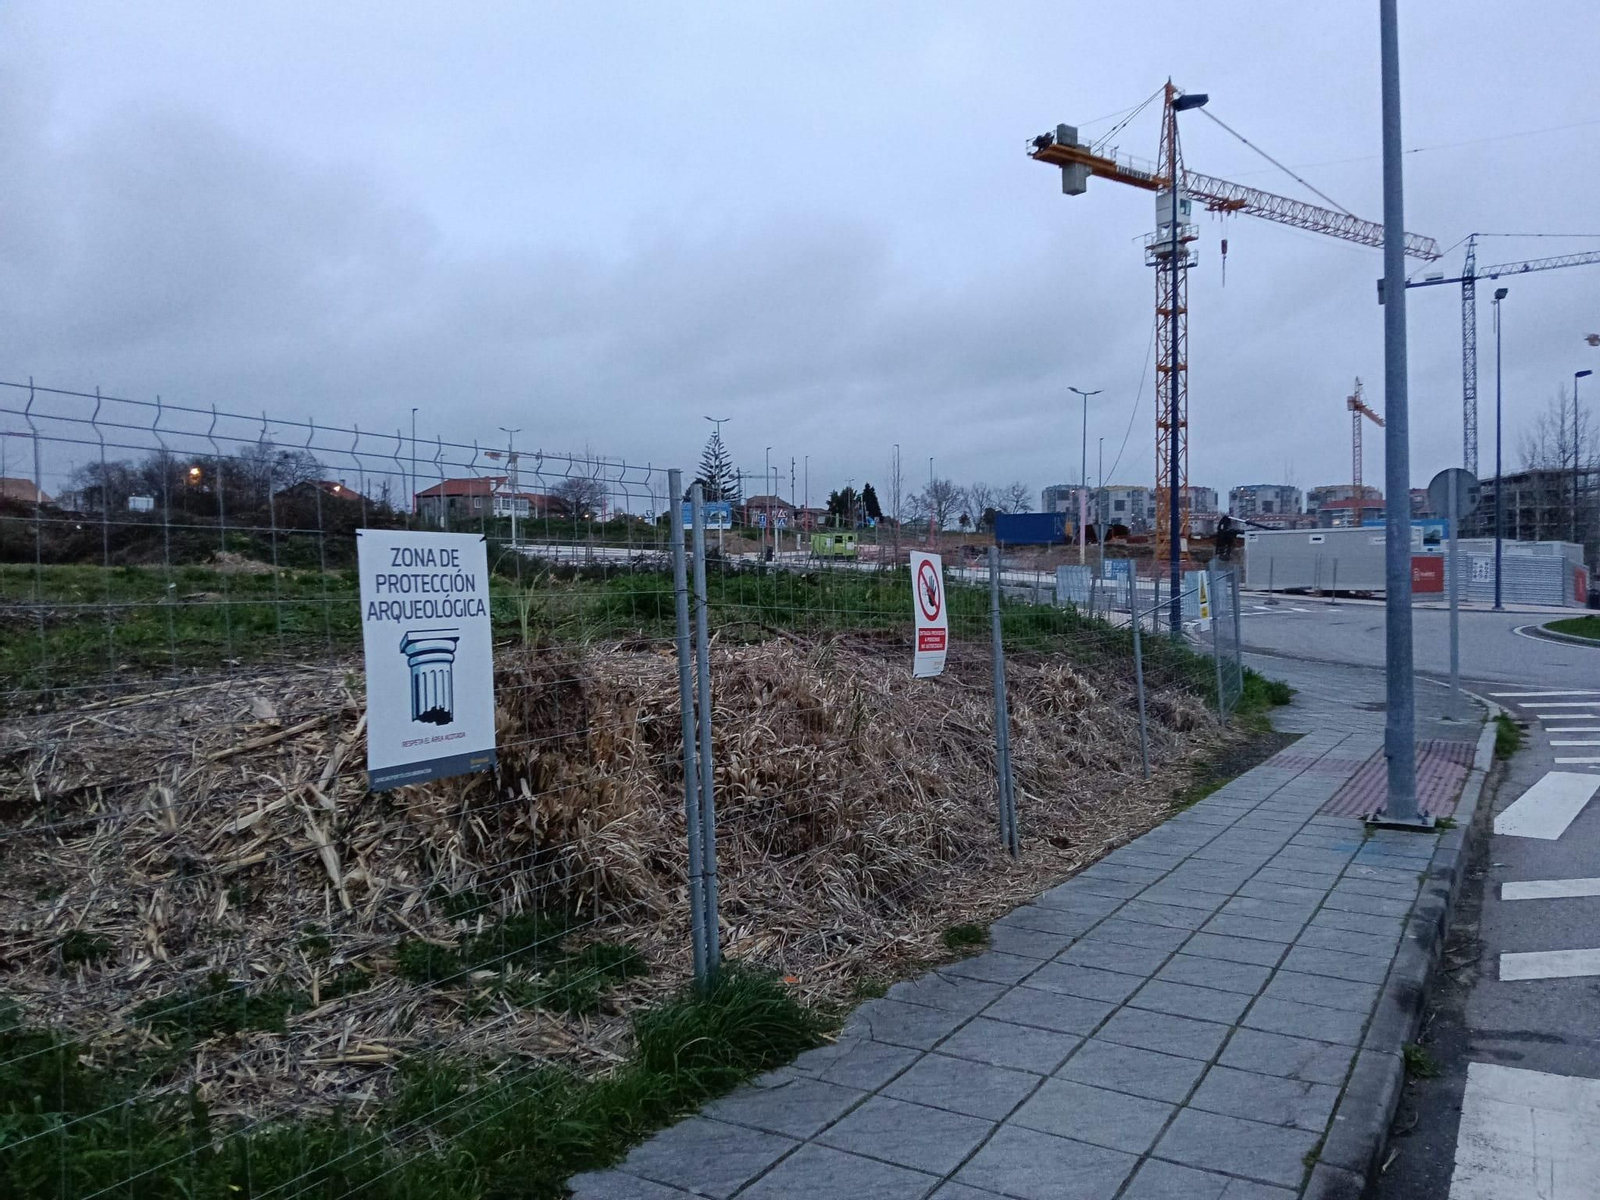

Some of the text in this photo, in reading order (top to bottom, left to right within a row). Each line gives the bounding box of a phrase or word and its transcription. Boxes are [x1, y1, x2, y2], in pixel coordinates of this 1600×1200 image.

[390, 547, 460, 567] ZONA DE
[375, 568, 475, 593] PROTECCIÓN
[367, 594, 486, 623] ARQUEOLÓGICA
